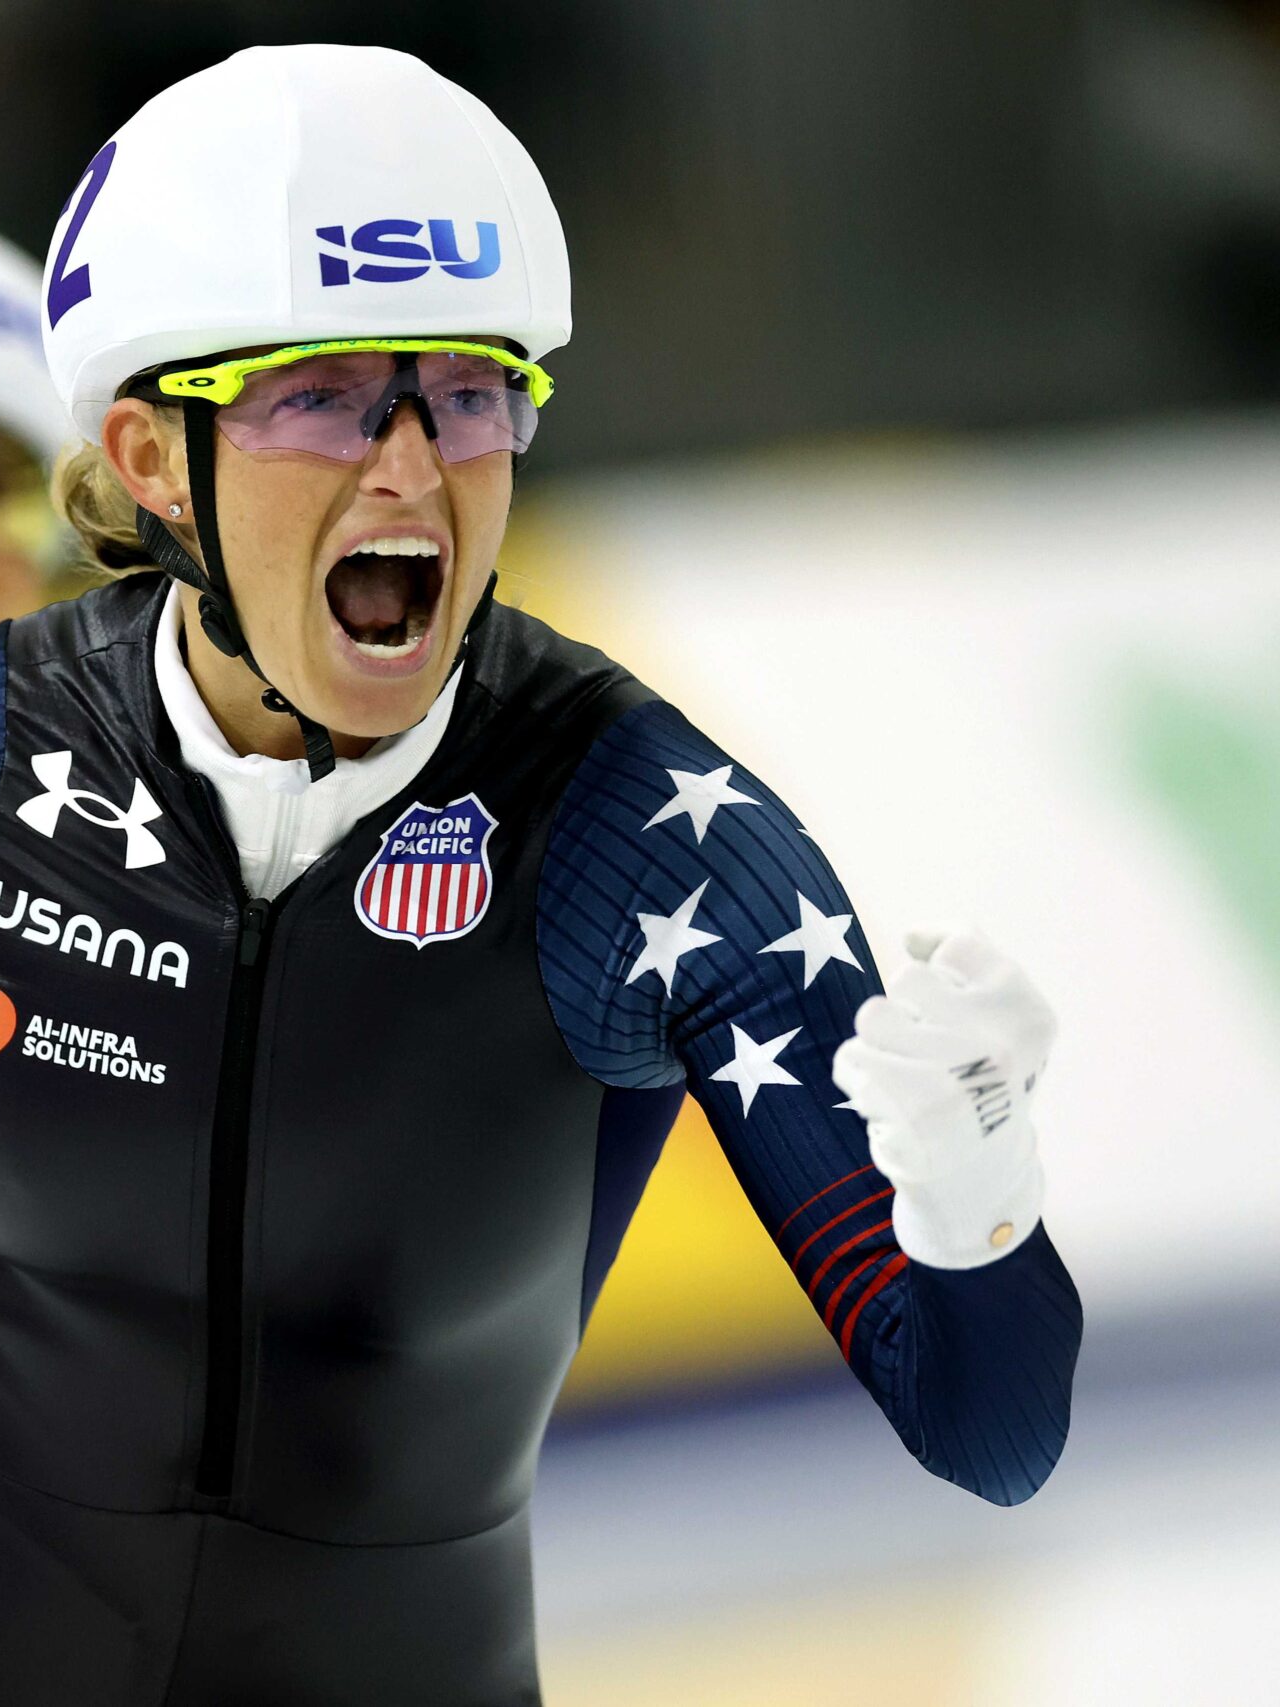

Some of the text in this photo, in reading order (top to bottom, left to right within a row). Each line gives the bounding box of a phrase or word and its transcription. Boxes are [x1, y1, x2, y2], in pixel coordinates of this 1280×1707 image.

[315, 218, 502, 287] ISU
[390, 837, 474, 856] PACIFIC
[401, 817, 472, 838] UNION
[25, 1014, 138, 1058] AI-INFRA
[22, 1035, 167, 1085] SOLUTIONS
